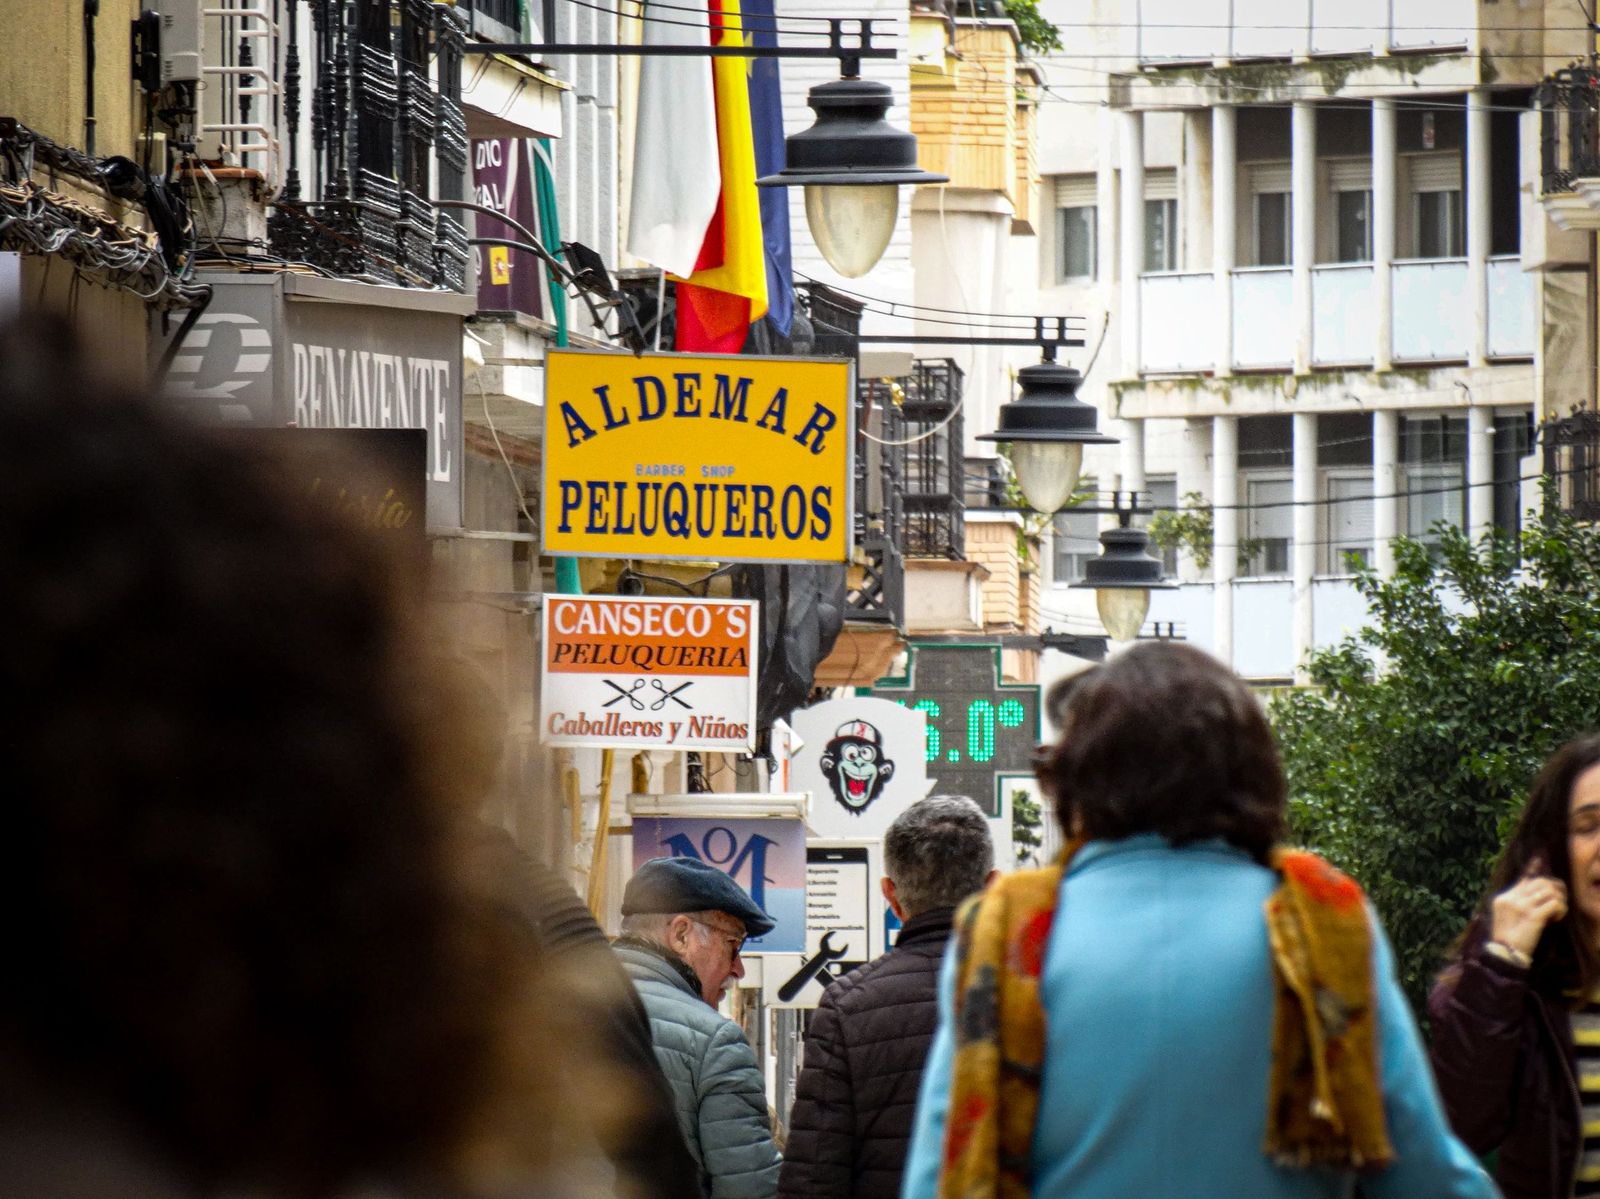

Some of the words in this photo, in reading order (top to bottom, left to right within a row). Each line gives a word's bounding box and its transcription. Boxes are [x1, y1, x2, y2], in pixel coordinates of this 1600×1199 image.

[559, 372, 837, 456] ALDEMAR
[635, 464, 685, 477] BARBER
[701, 465, 736, 478] SHOP
[557, 480, 833, 541] PELUQUEROS
[552, 643, 749, 670] PELUQUERIA
[548, 712, 663, 738] Caballeros
[666, 722, 683, 744] y
[686, 715, 749, 739] Niños
